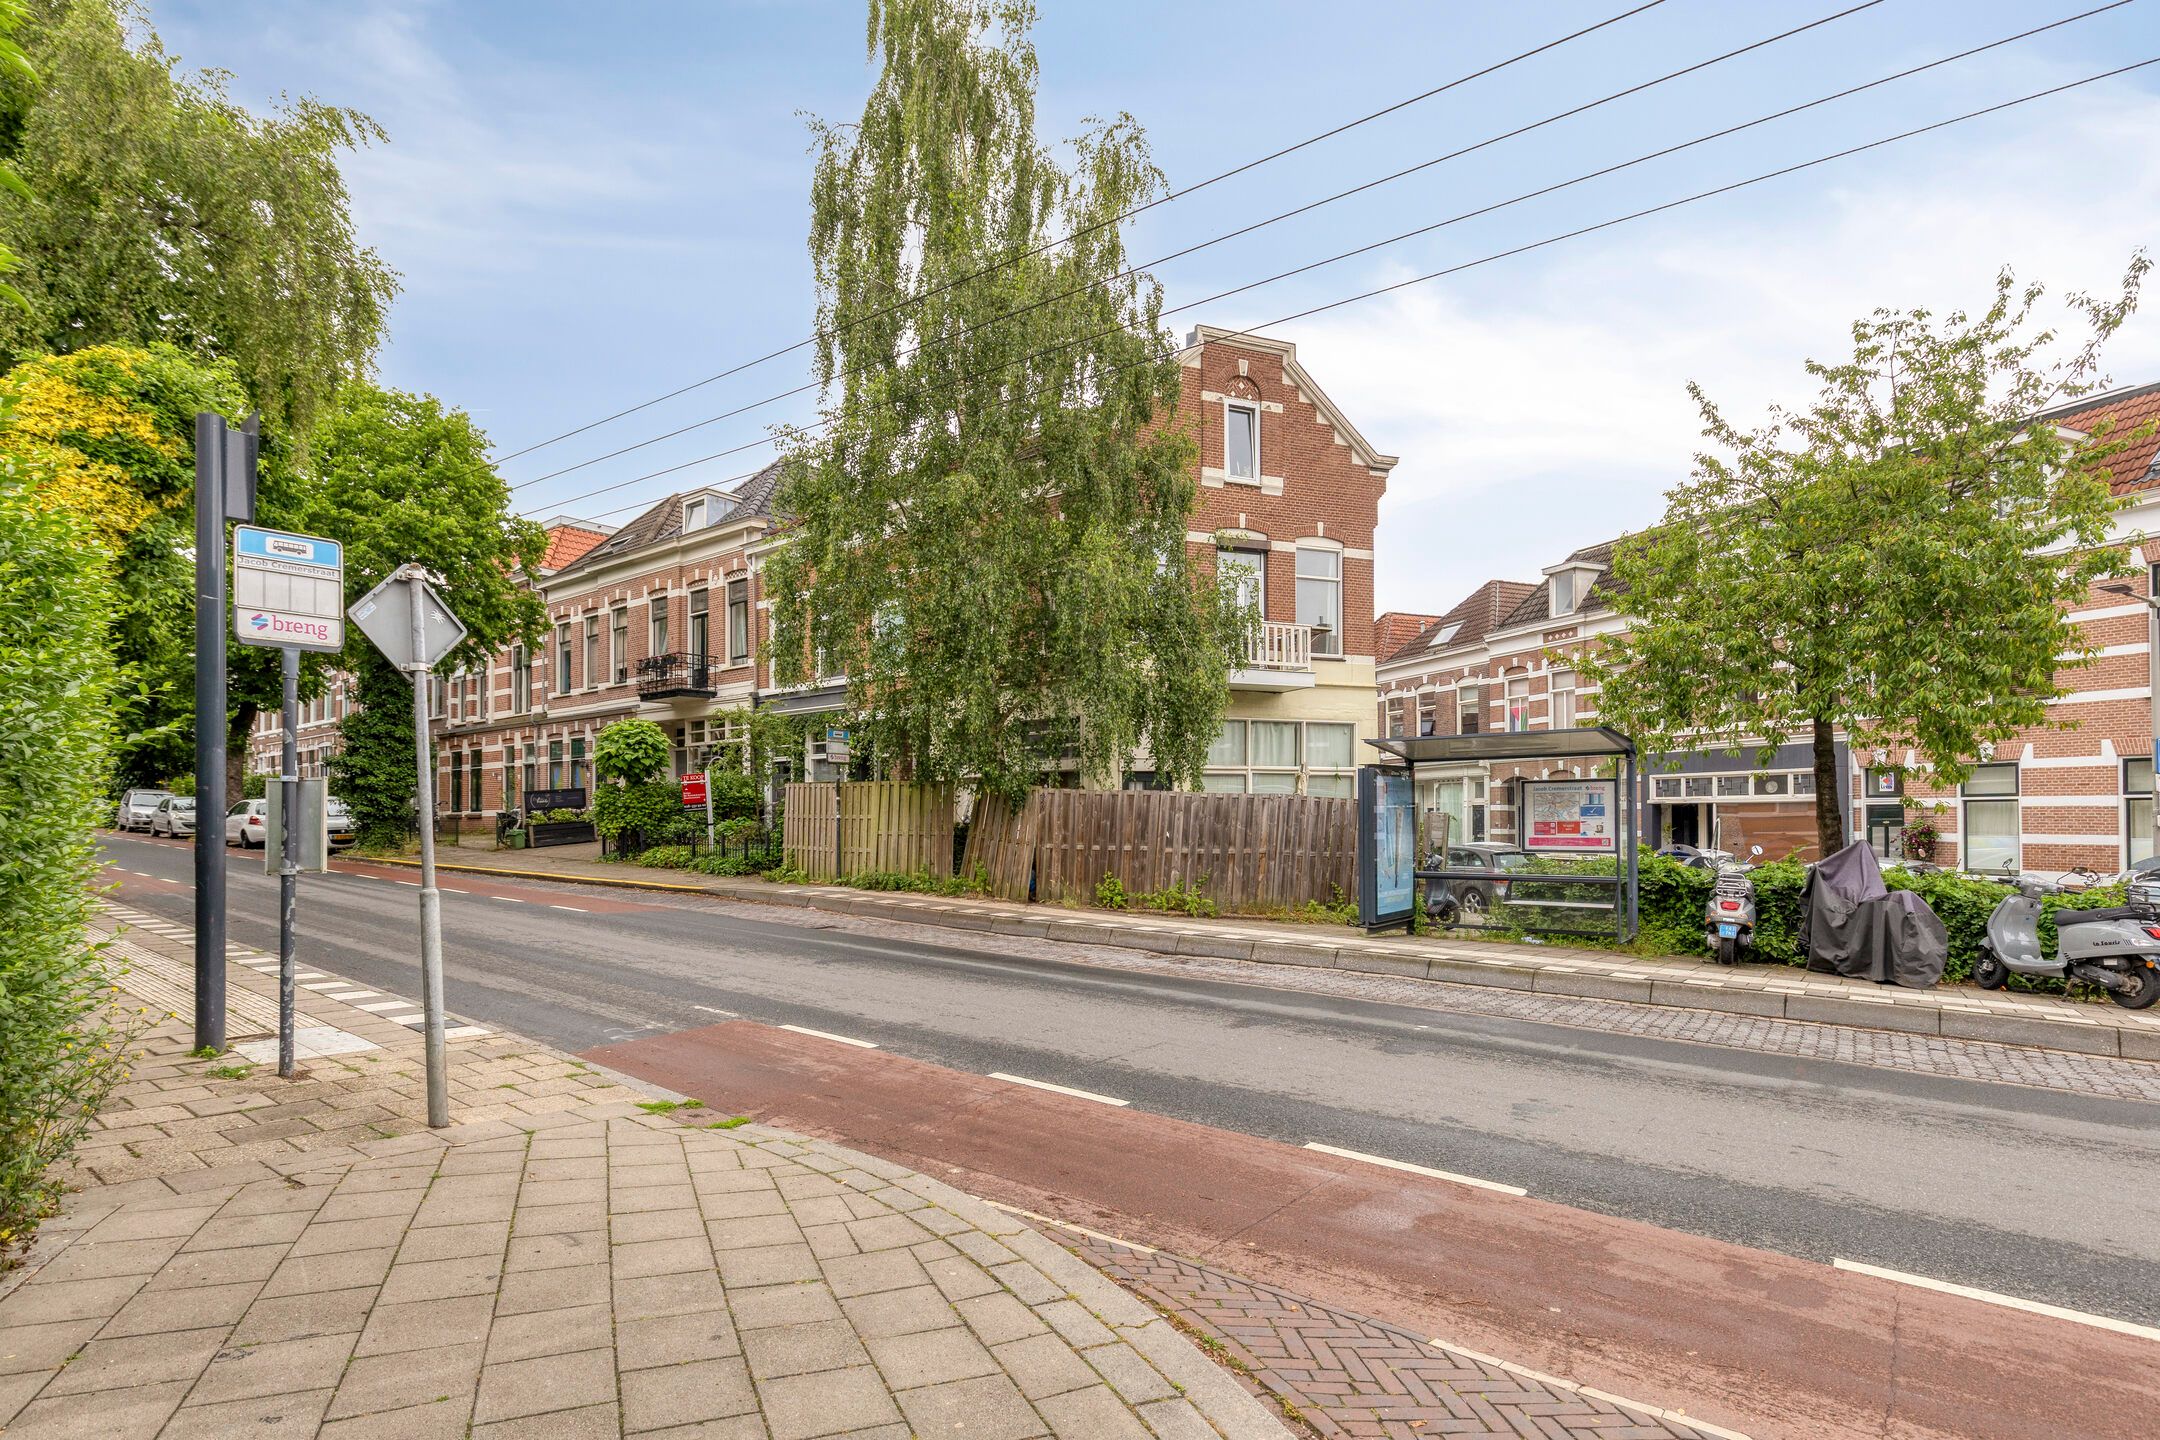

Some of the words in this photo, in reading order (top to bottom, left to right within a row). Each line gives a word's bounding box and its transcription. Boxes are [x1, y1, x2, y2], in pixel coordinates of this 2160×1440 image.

[239, 557, 268, 567] Jacob
[271, 561, 336, 577] Cremerstraat
[272, 614, 328, 640] breng
